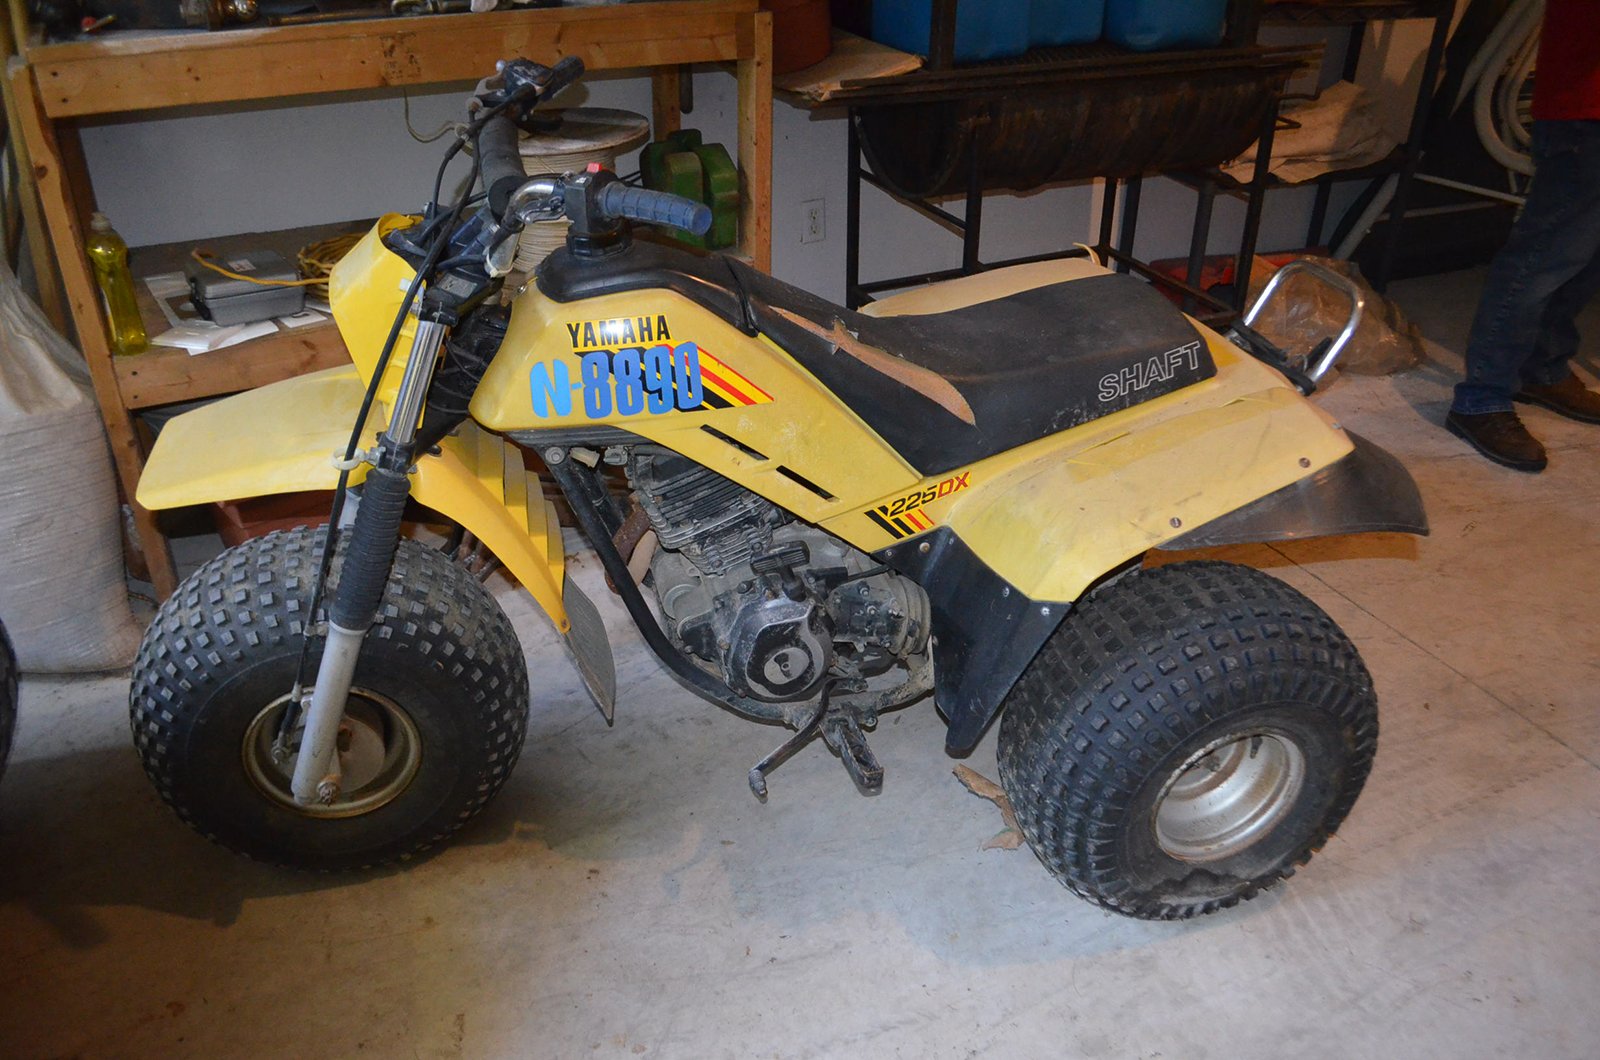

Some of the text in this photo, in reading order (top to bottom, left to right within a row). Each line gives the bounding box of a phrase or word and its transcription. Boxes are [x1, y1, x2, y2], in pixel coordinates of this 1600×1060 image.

[566, 315, 671, 348] YAMAHA
[529, 341, 704, 419] N-8890
[1098, 340, 1200, 402] SHAFT
